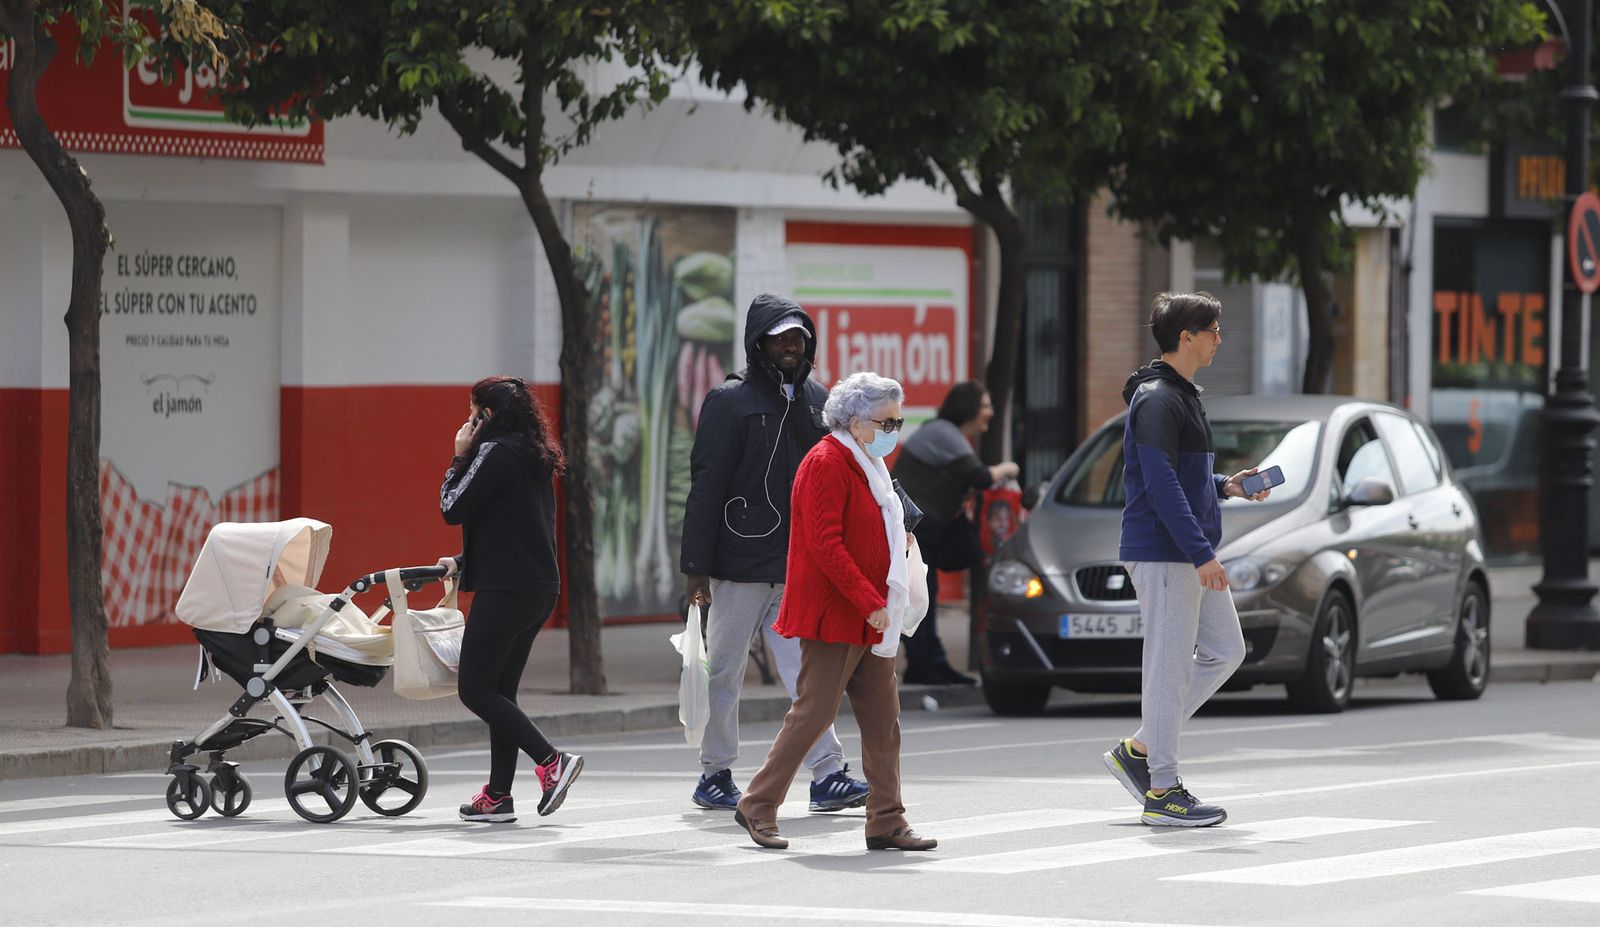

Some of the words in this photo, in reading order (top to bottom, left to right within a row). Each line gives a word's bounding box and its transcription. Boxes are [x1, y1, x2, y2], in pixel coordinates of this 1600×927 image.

[117, 254, 131, 277] EL
[134, 250, 174, 278] SÚPER
[177, 254, 239, 282] CERCANO,
[114, 286, 154, 315] SÚPER
[157, 292, 186, 316] CON
[189, 293, 205, 316] TU
[208, 293, 258, 317] ACENTO
[1433, 290, 1545, 366] TINTE
[153, 391, 164, 414] el
[164, 393, 203, 418] jamón
[1072, 616, 1118, 634] 5445
[1164, 802, 1188, 815] HOKA
